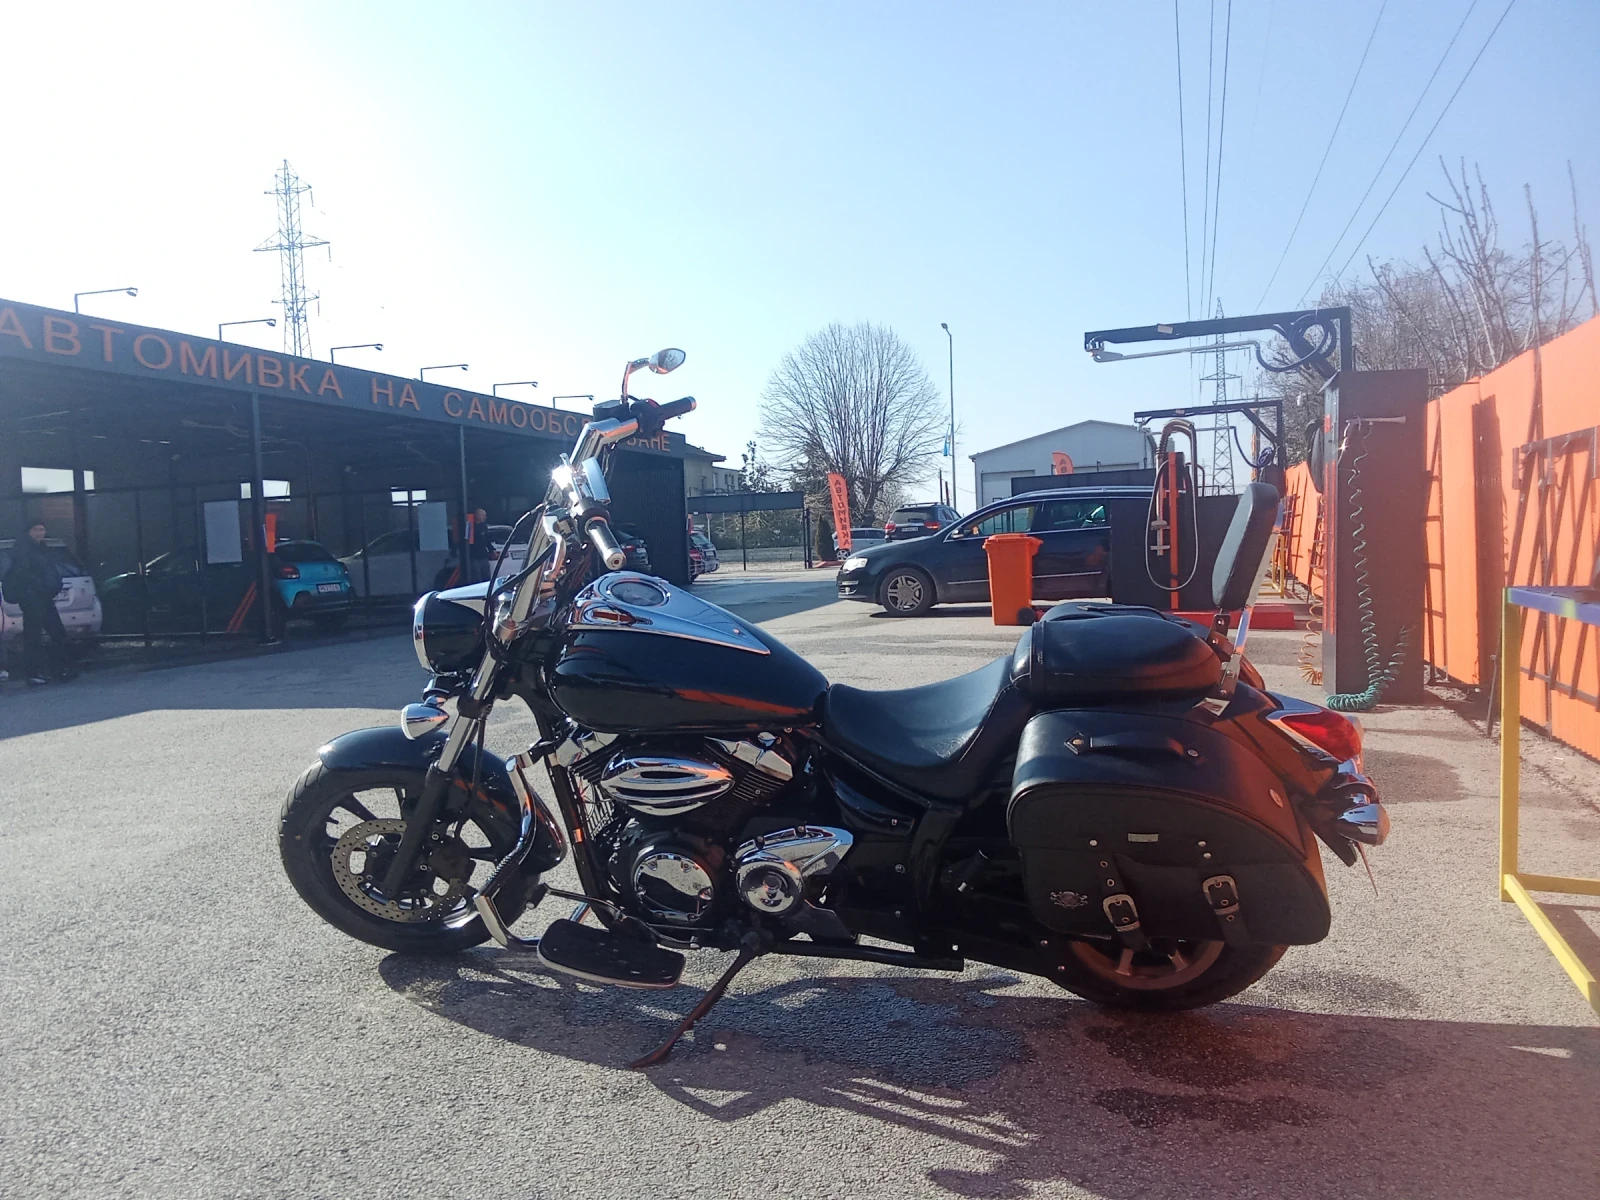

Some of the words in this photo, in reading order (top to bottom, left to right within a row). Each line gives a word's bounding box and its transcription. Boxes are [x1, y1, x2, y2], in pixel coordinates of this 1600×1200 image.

[0, 307, 343, 399] АВТОМИВКА
[371, 377, 420, 411] НА
[443, 391, 670, 452] САМООБСАНЕ
